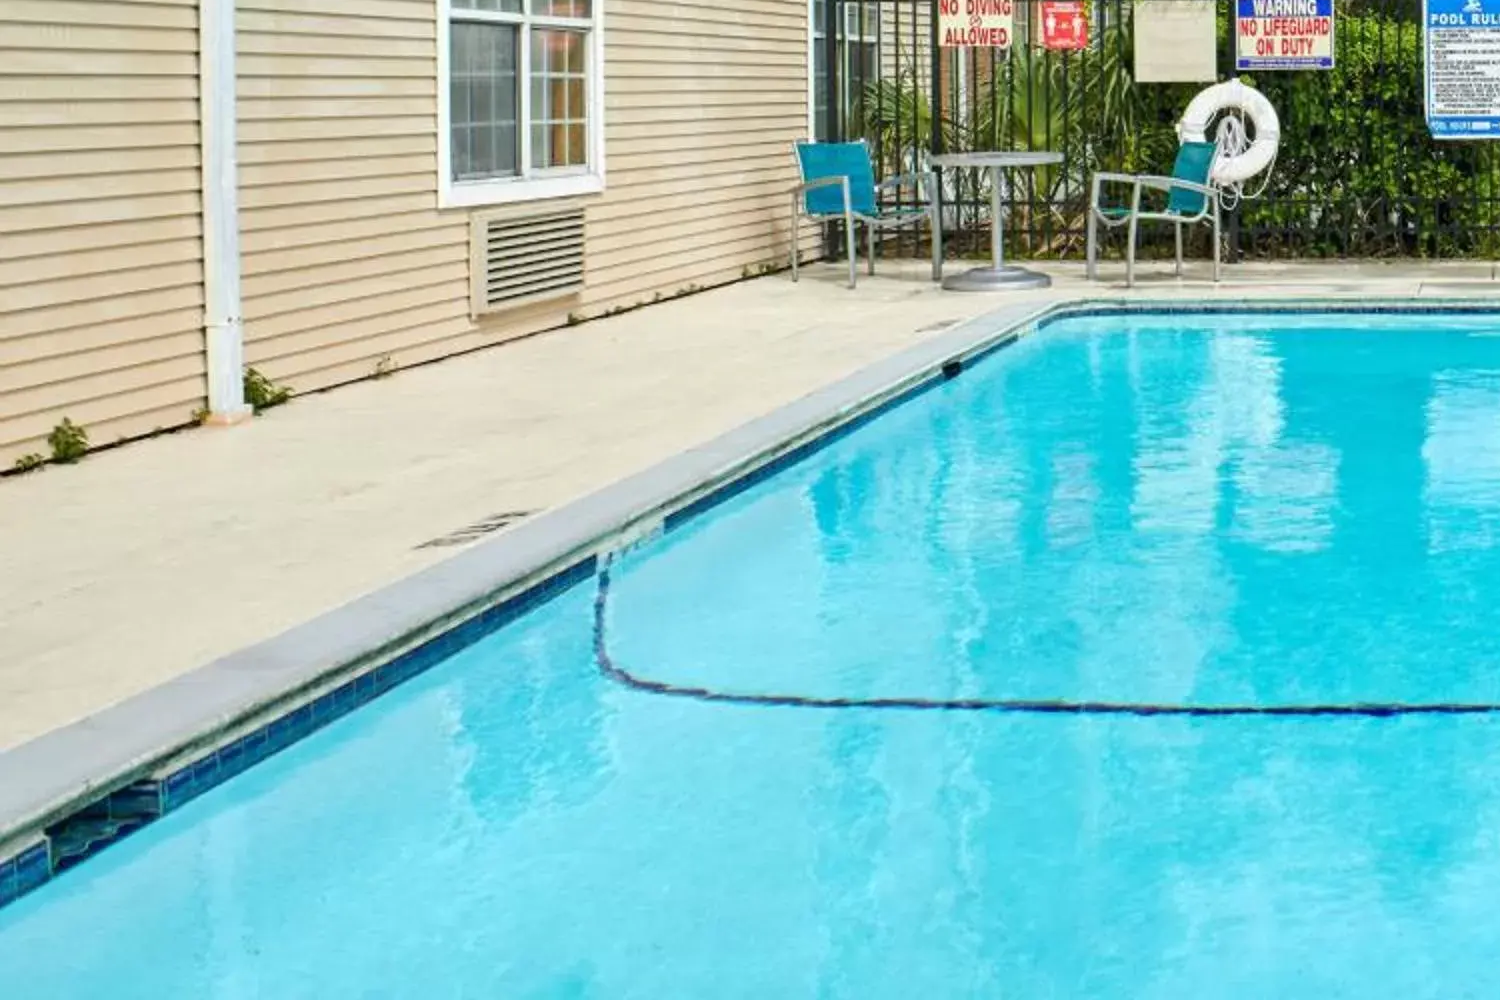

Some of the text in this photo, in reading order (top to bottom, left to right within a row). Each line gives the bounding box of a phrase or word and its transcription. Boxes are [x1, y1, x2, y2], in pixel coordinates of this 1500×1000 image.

[1241, 18, 1329, 36] NO LIFEGUARD
[1431, 14, 1466, 25] POOL
[945, 28, 1008, 45] ALLOWED
[1257, 38, 1313, 55] ON DUTY
